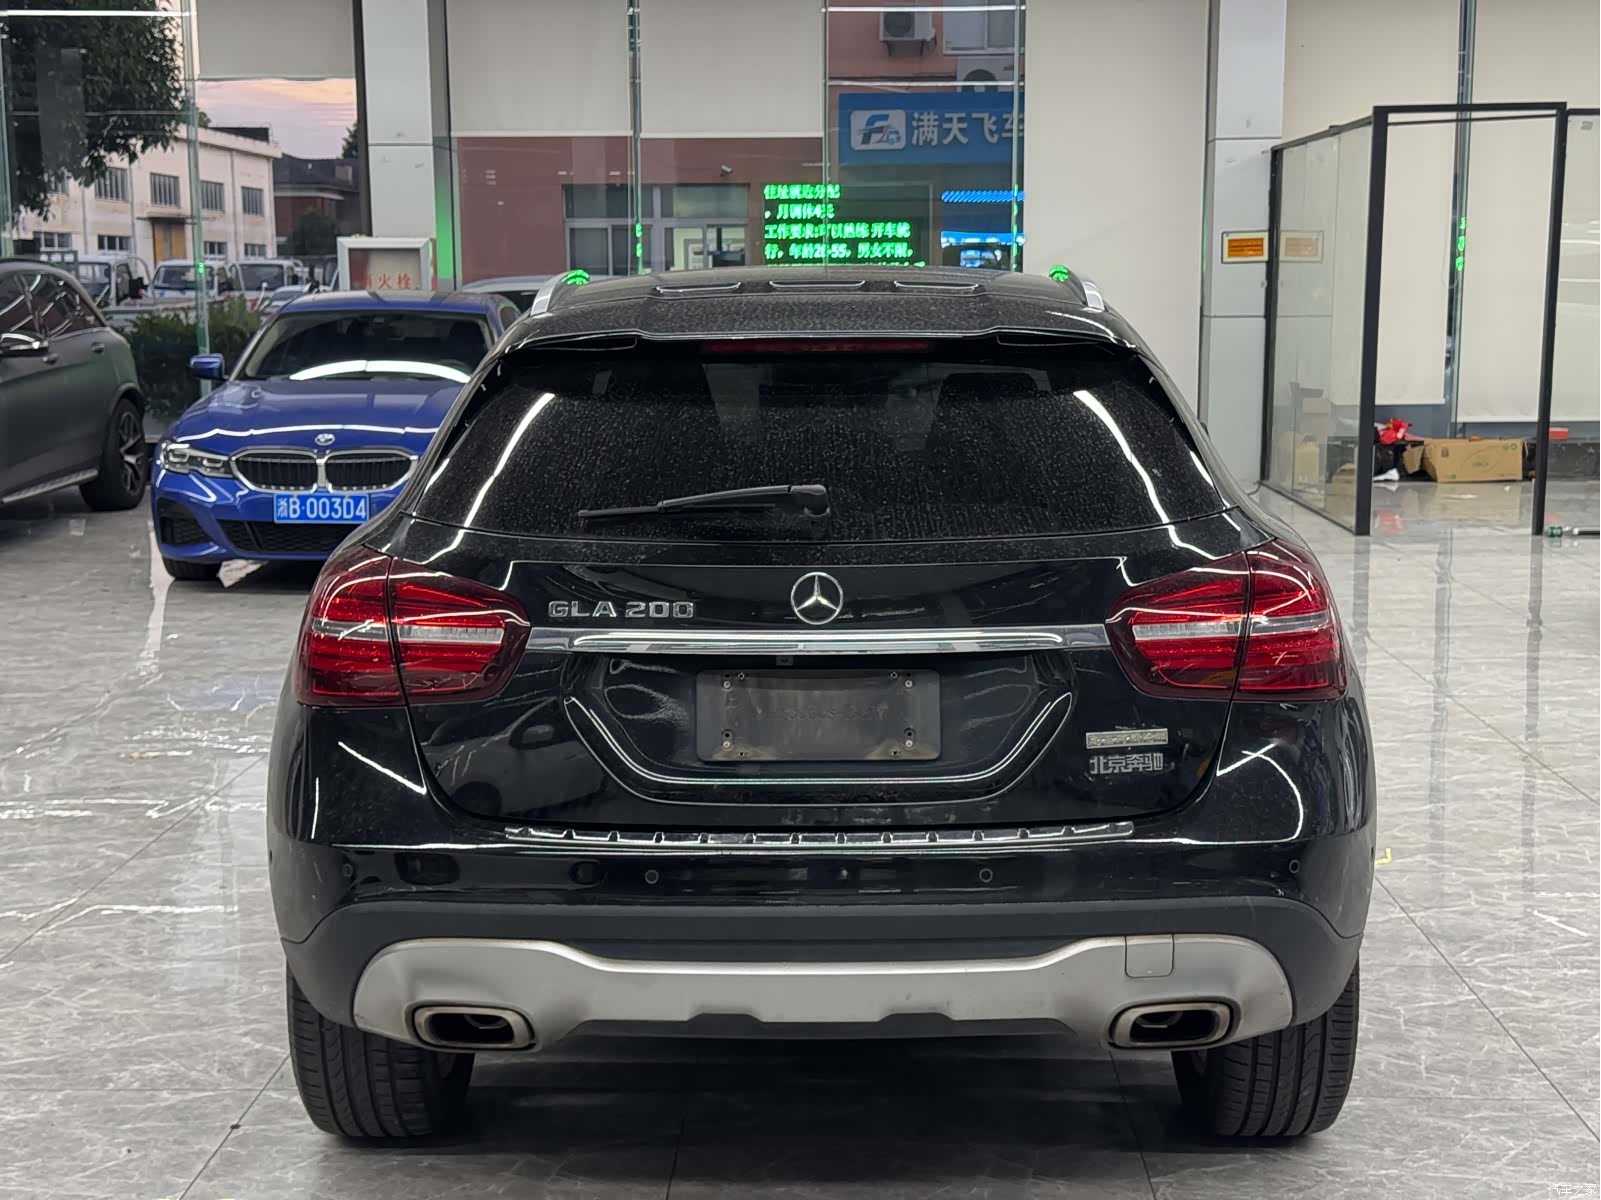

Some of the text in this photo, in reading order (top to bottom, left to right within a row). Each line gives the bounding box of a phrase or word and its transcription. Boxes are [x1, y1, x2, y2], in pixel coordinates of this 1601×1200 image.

[549, 600, 694, 618] GLA 200
[1090, 752, 1163, 774] 北京奔驰
